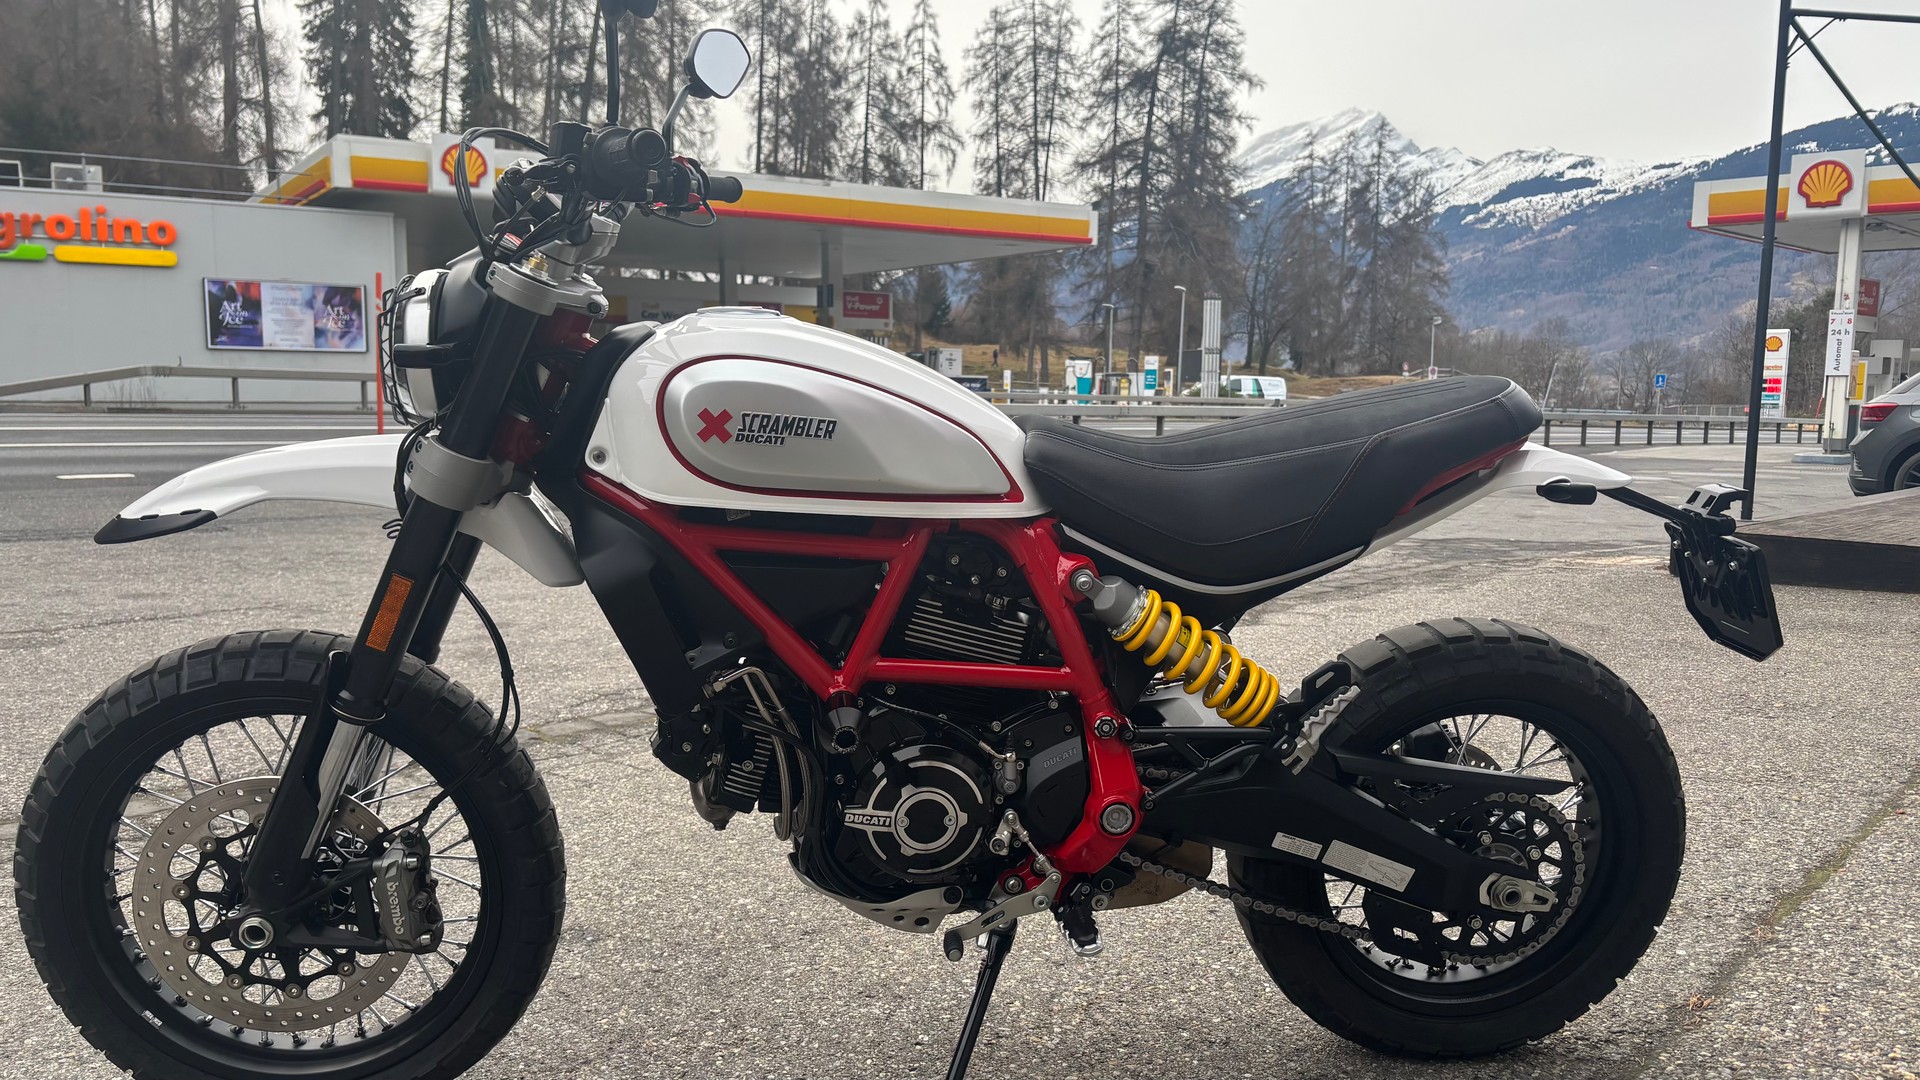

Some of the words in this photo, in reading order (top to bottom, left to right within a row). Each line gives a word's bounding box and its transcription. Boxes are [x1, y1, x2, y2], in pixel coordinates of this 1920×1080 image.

[219, 300, 242, 316] Art
[323, 304, 345, 317] Art
[846, 302, 881, 311] V-Power
[641, 310, 659, 319] Car
[1833, 338, 1843, 372] Automat
[737, 411, 837, 440] SCRAMBLER
[735, 433, 786, 446] DUCATI
[1043, 747, 1077, 769] DUCATI
[845, 813, 891, 826] DUCATI
[386, 881, 406, 935] brembo
